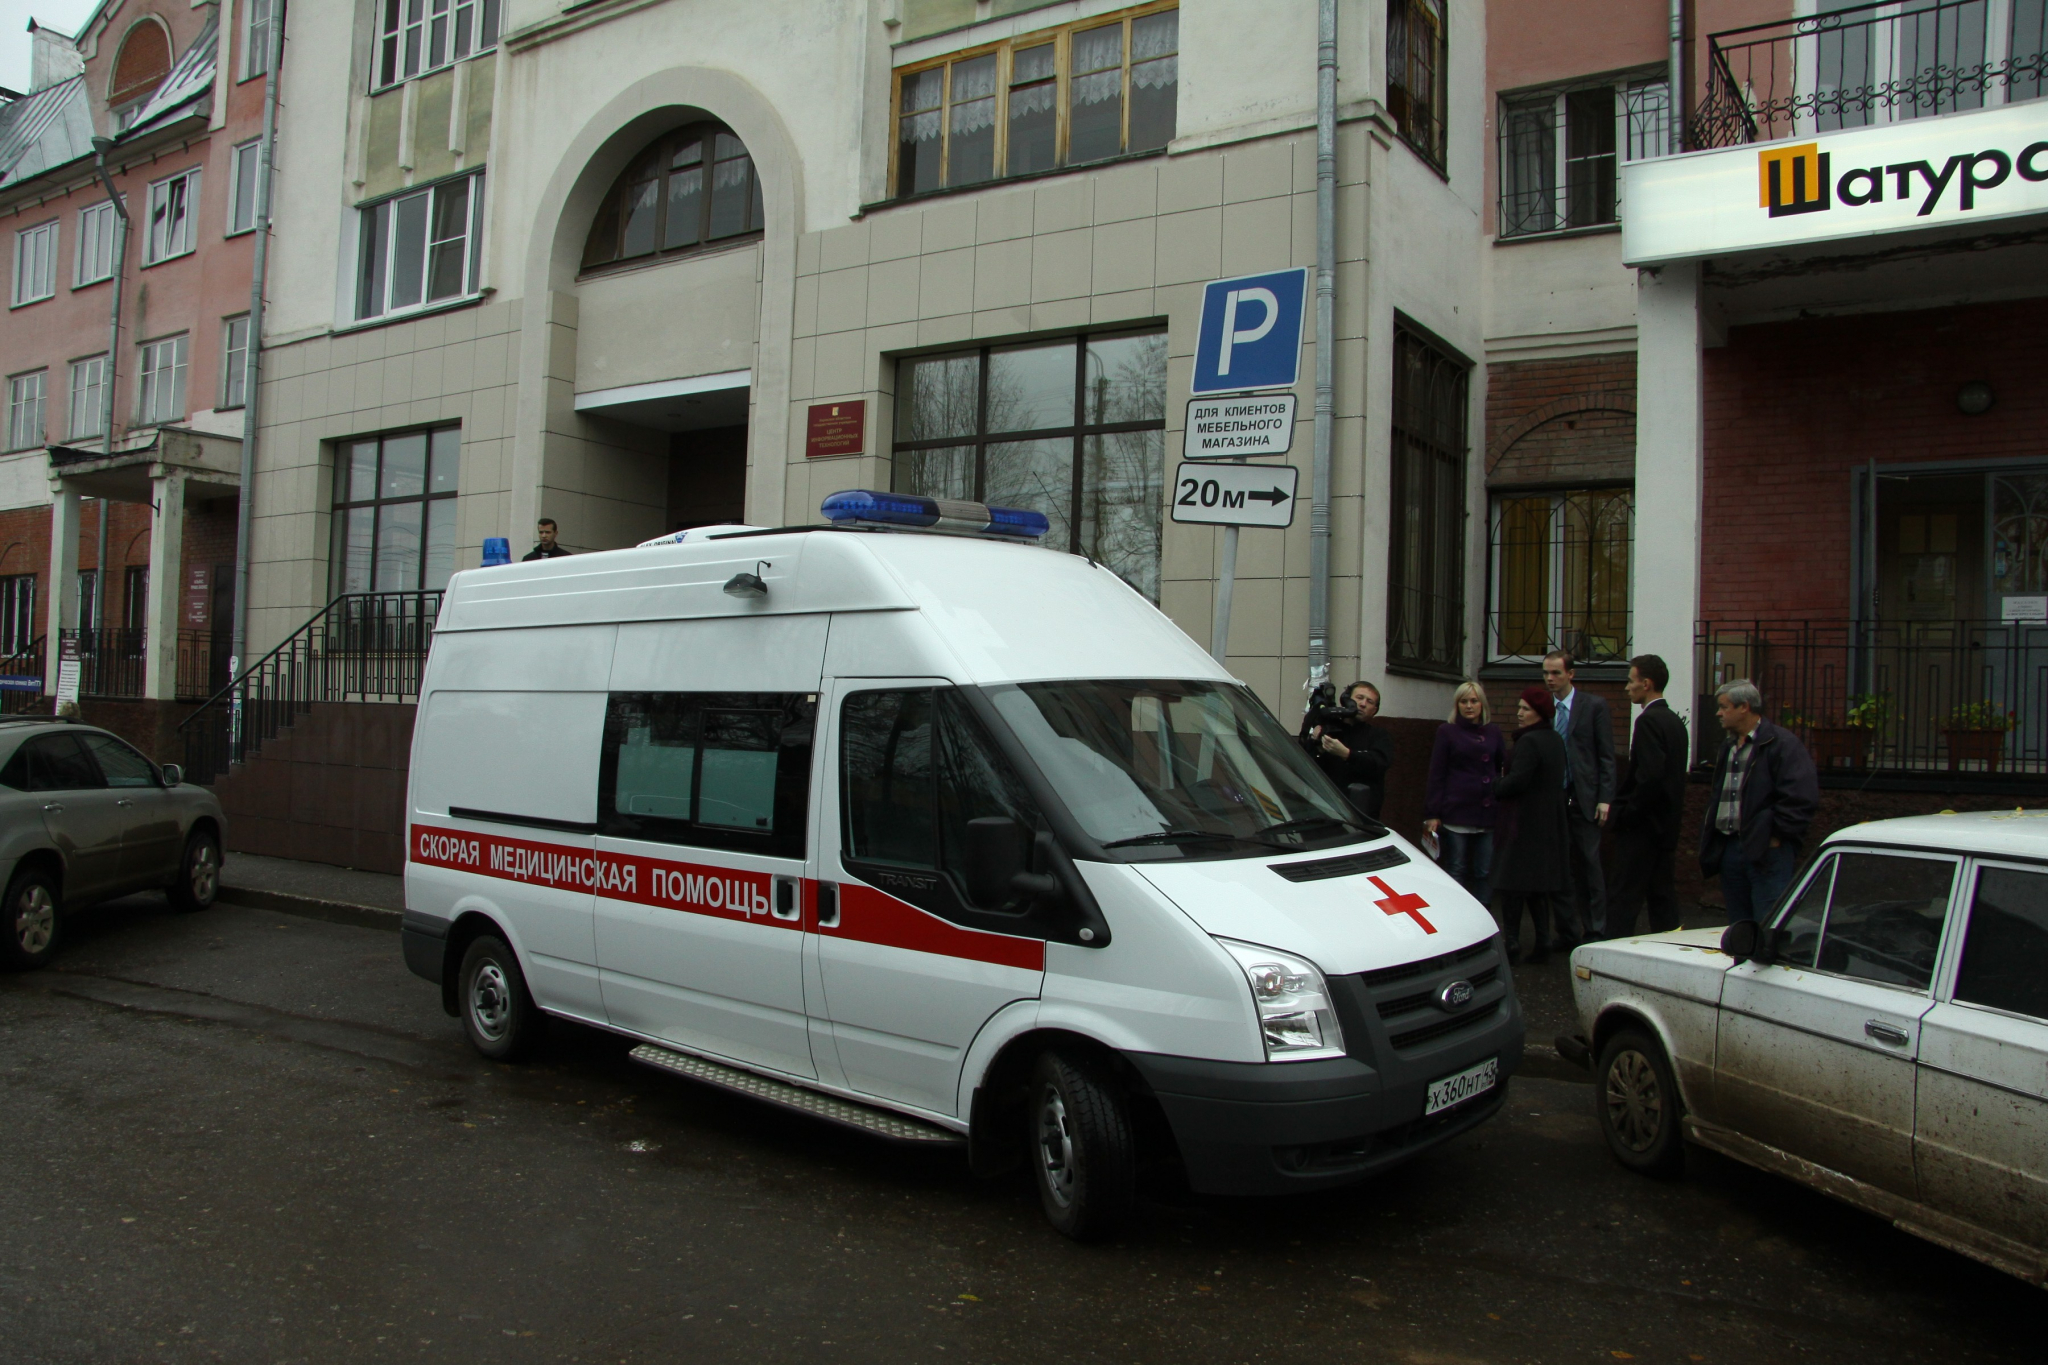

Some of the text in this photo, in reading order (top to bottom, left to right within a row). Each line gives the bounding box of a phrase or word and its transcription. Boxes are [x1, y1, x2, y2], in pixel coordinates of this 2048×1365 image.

[1194, 403, 1286, 420] ДЛЯ КЛИЕНТОВ
[1197, 418, 1283, 434] МЕБЕЛЬНОГО
[1202, 435, 1270, 449] МАГАЗИНА
[420, 833, 769, 919] СКОРАЯ МЕДИЦИНСКАЯ ПОМОЩЬ
[878, 872, 937, 890] TRANSIT
[1452, 986, 1470, 1004] Ford
